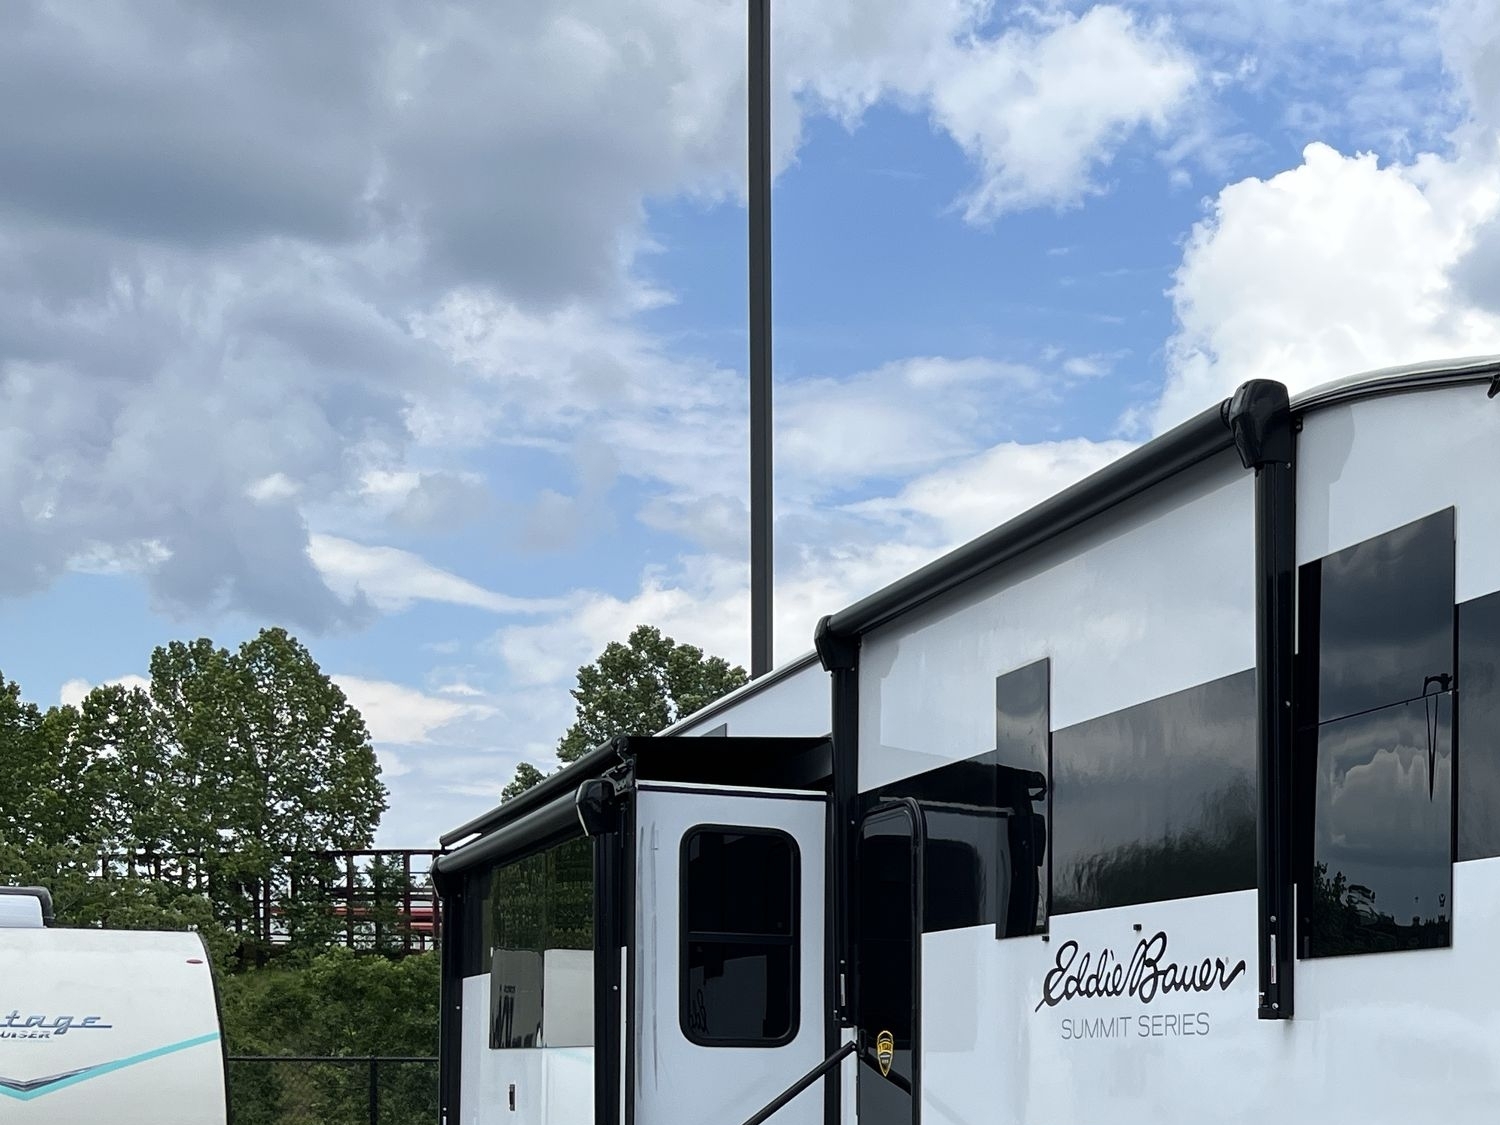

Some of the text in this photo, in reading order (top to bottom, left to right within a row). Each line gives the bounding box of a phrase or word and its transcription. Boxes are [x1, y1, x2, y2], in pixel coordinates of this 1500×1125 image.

[1034, 931, 1246, 1013] Eddie Bauer
[0, 1030, 51, 1039] UISER
[1061, 1012, 1210, 1040] SUMMIT SERIES
